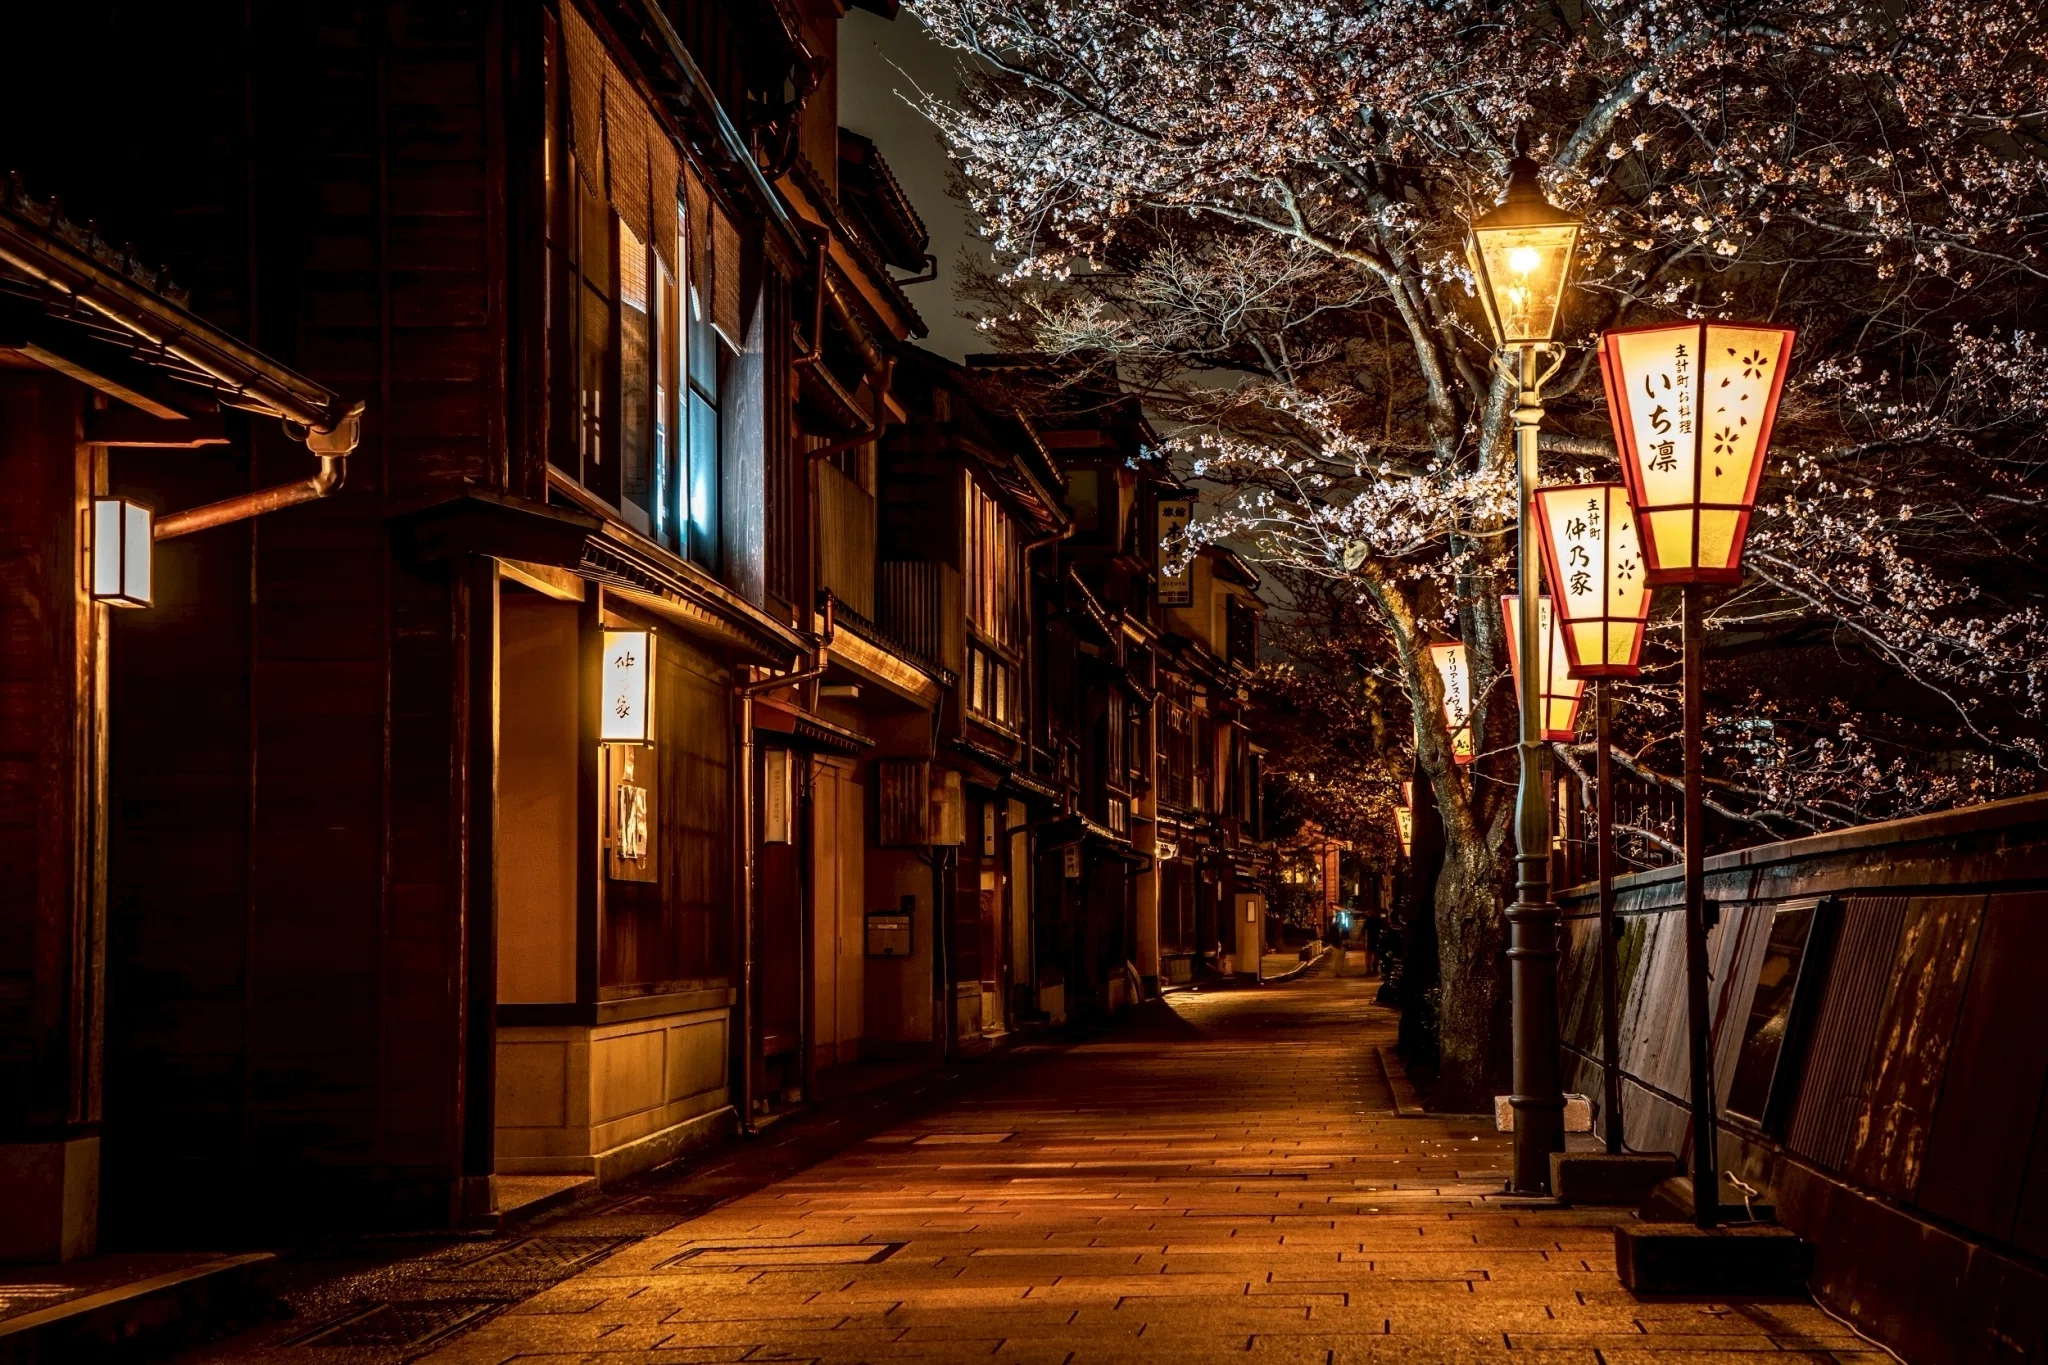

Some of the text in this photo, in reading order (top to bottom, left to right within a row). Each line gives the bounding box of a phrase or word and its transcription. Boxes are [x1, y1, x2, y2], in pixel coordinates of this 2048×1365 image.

[1645, 373, 1678, 473] いち凛
[1675, 344, 1692, 434] 主計町お料理
[1565, 517, 1593, 597] 仲乃家
[1587, 498, 1601, 541] 主計町
